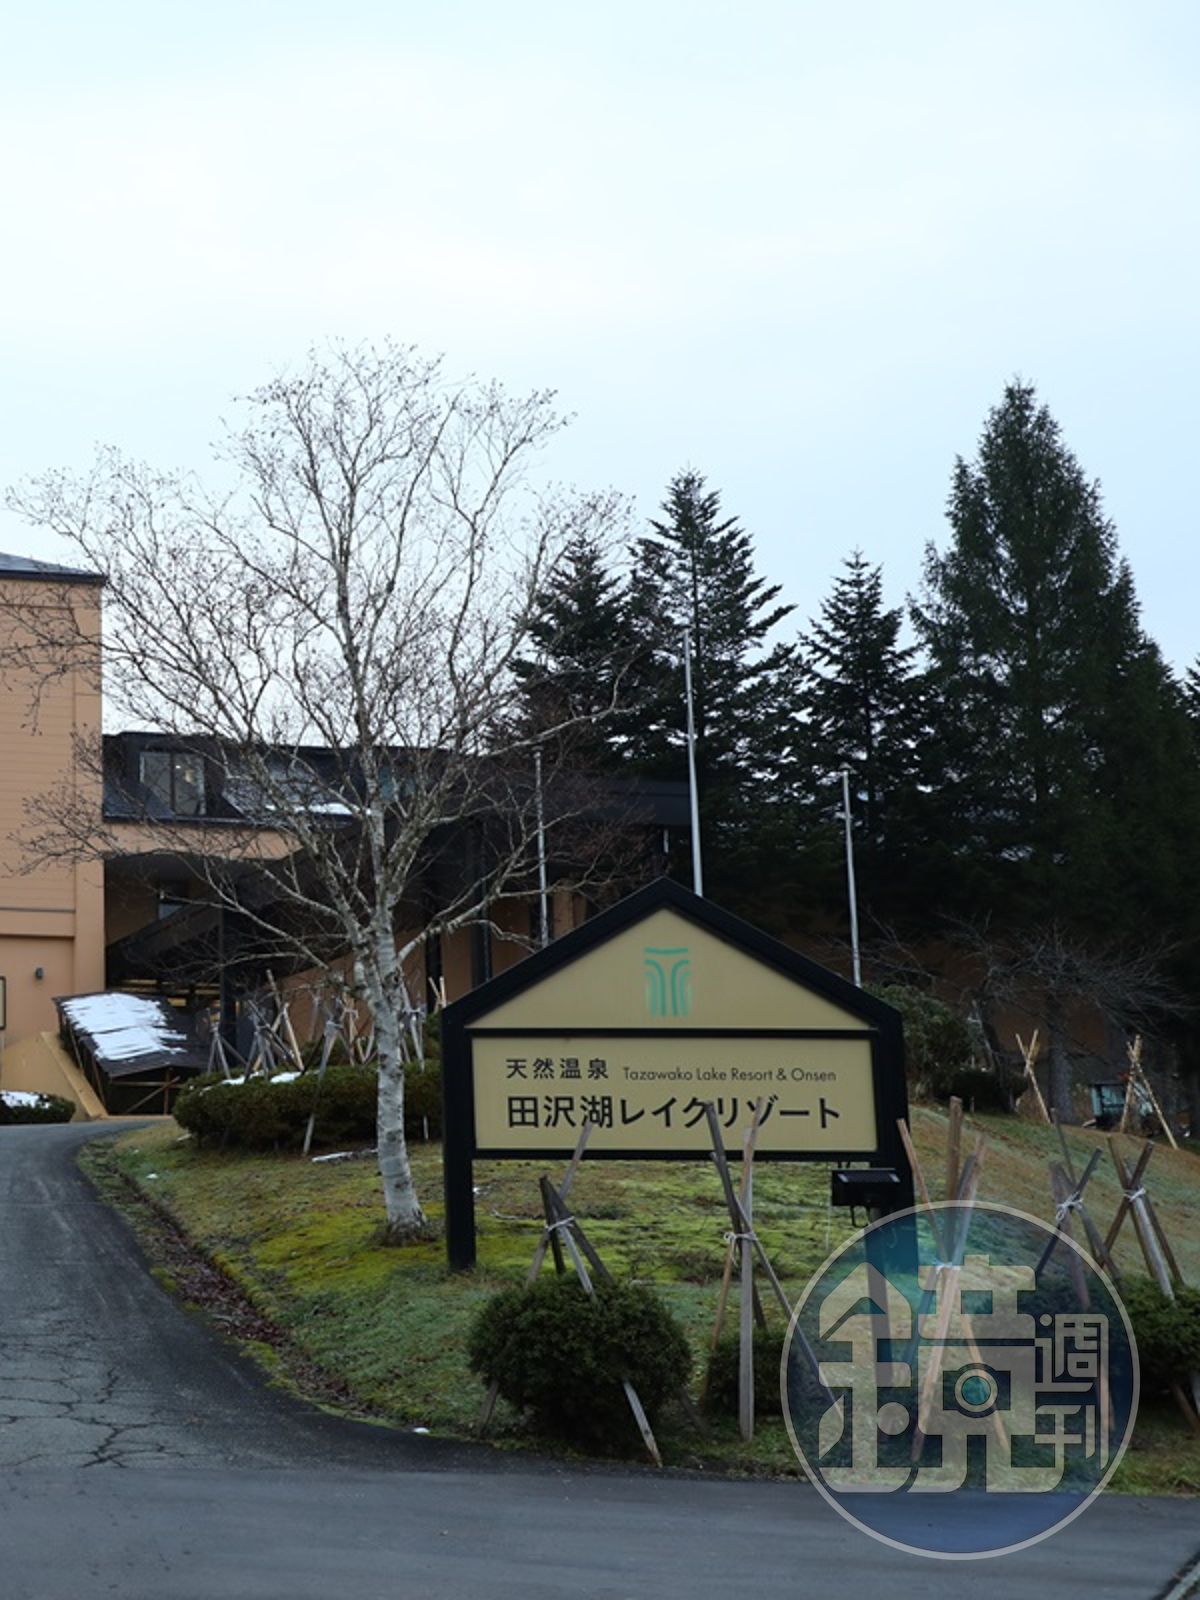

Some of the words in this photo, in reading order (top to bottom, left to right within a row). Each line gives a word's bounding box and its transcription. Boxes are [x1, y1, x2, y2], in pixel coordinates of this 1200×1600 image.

[505, 1057, 609, 1081] 天然温泉
[623, 1066, 693, 1081] Tazawako
[696, 1067, 727, 1081] Lake
[731, 1067, 773, 1081] Resort
[776, 1067, 787, 1081] &
[791, 1067, 837, 1082] Onsen
[507, 1094, 841, 1129] 田沢湖レイクリゾート
